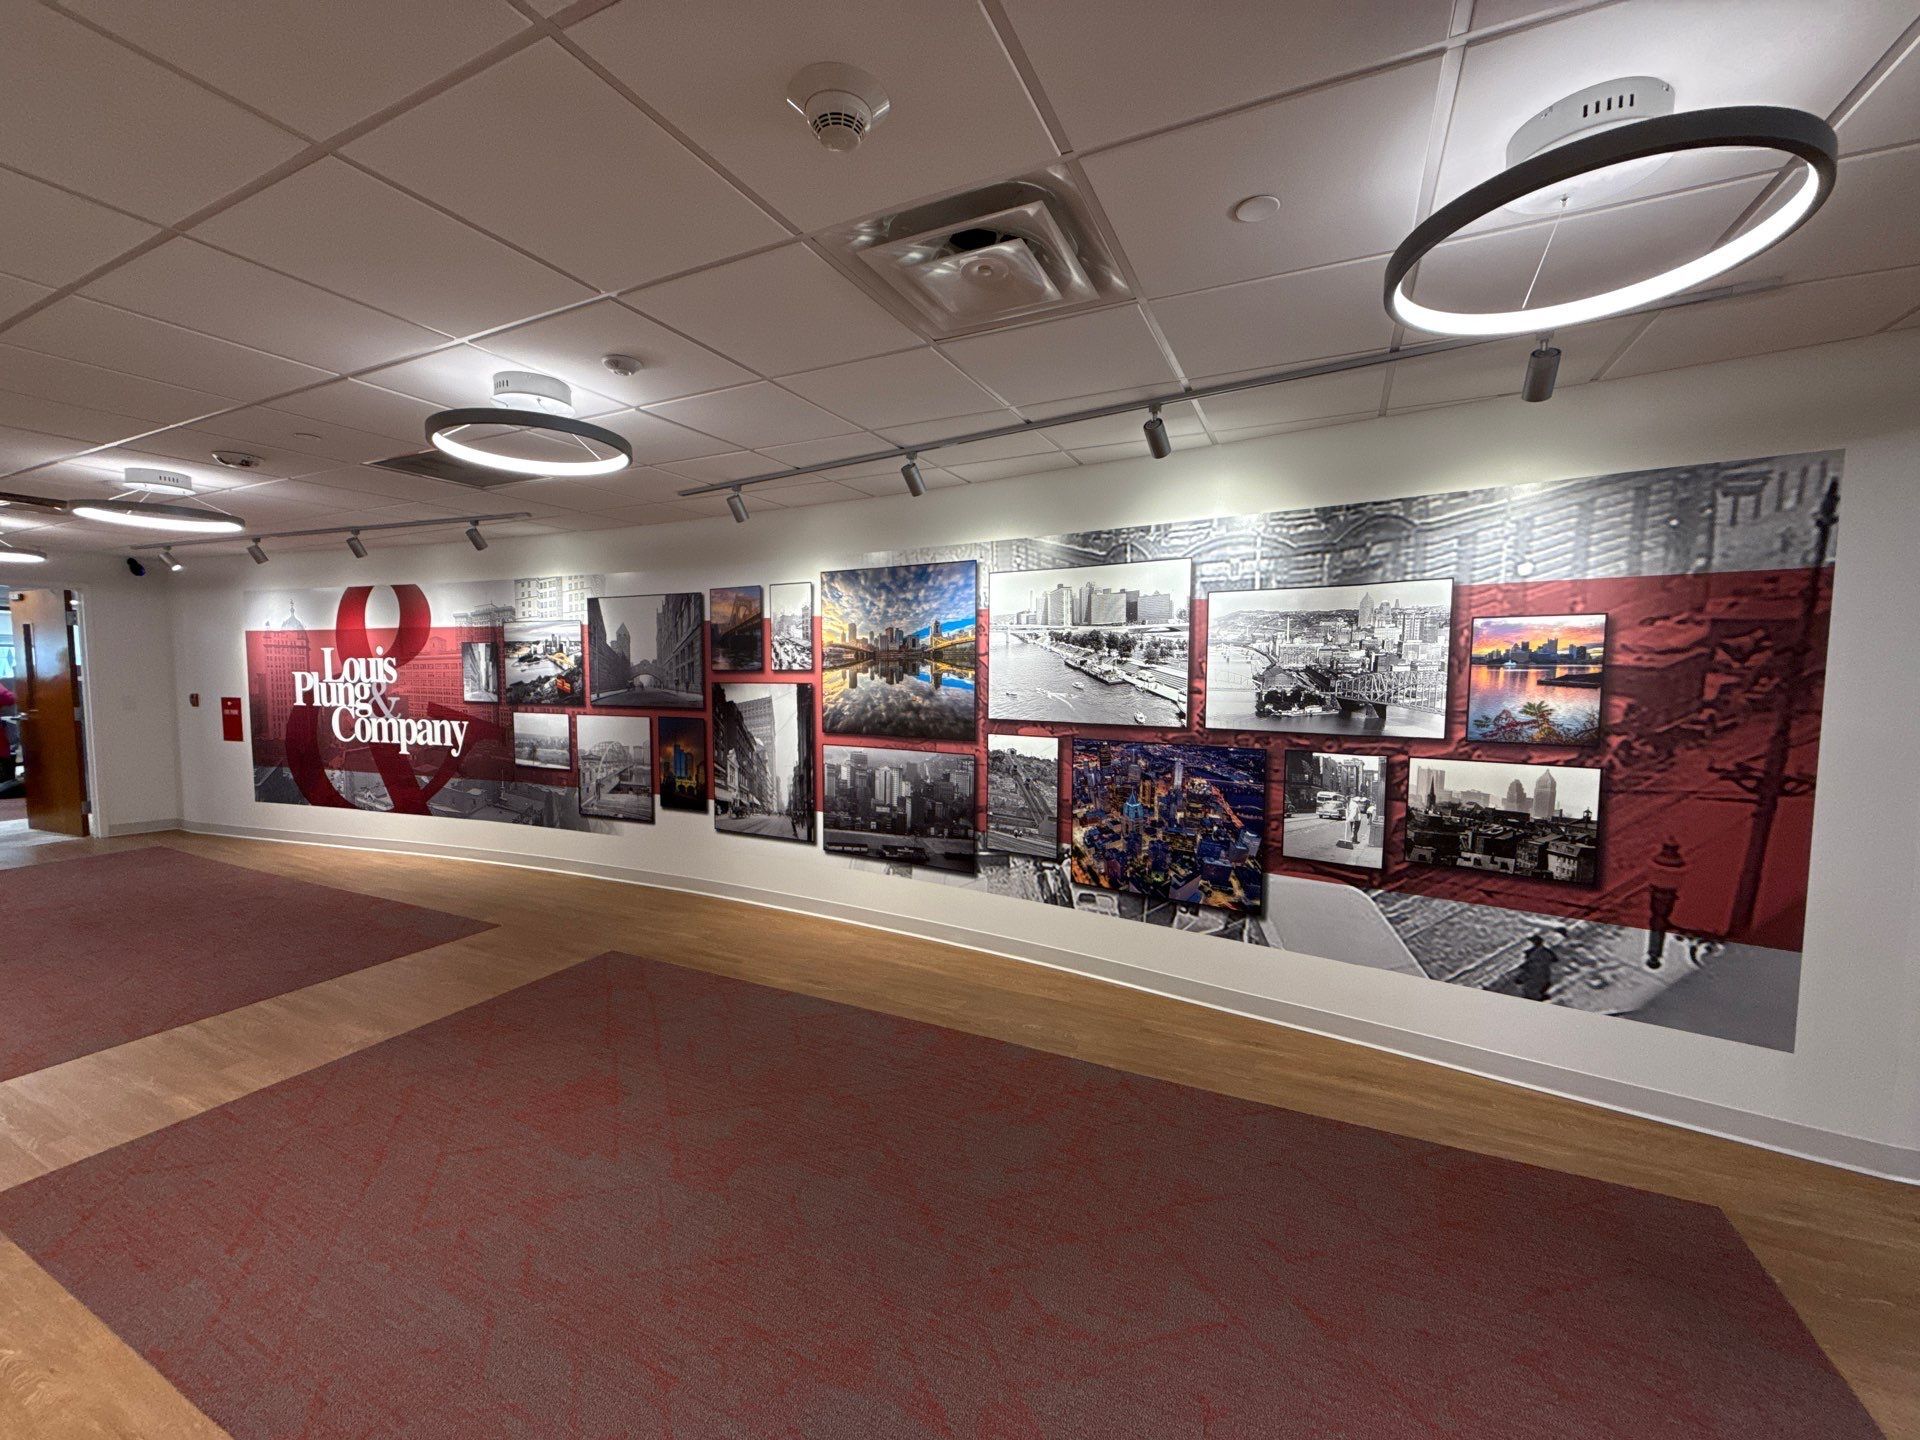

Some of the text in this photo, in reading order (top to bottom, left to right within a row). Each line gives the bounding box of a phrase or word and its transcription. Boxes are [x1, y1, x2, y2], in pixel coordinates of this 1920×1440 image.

[320, 645, 398, 684] Louis
[292, 671, 401, 719] Plung &
[331, 706, 469, 757] Company
